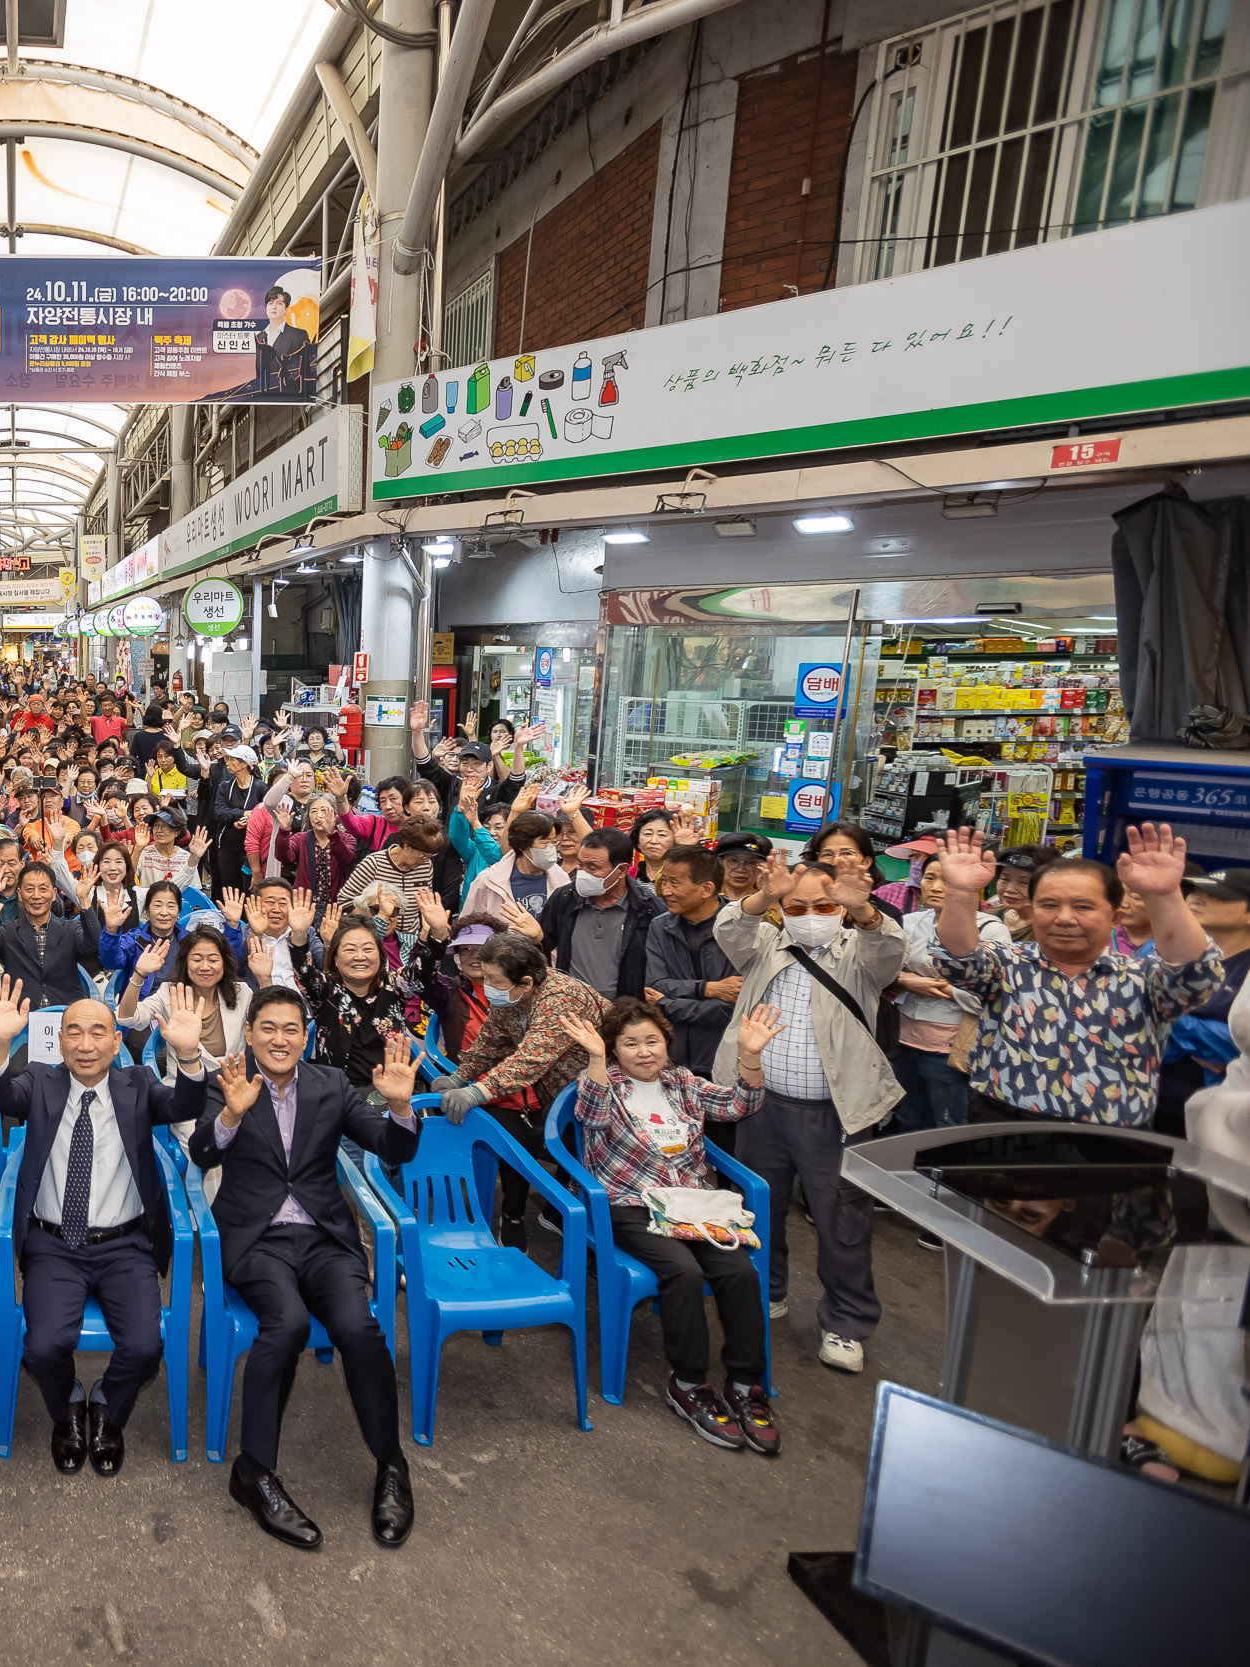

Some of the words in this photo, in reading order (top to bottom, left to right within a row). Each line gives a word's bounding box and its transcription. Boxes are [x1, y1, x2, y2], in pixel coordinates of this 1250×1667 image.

[122, 286, 208, 302] 16:00~20:00
[26, 307, 132, 326] 자양전통시장
[137, 307, 153, 326] 내
[29, 334, 48, 345] 고객
[49, 334, 68, 345] 감사
[97, 334, 116, 345] 행사
[870, 340, 892, 353] 다
[1070, 444, 1095, 460] 15
[233, 471, 275, 525] WOORI
[281, 435, 329, 502] MART
[192, 592, 235, 604] 우리마트
[203, 606, 224, 618] 생선
[207, 624, 221, 632] 생선
[807, 677, 840, 692] 담배
[1134, 787, 1189, 801] 은행공동
[1191, 787, 1235, 805] 365
